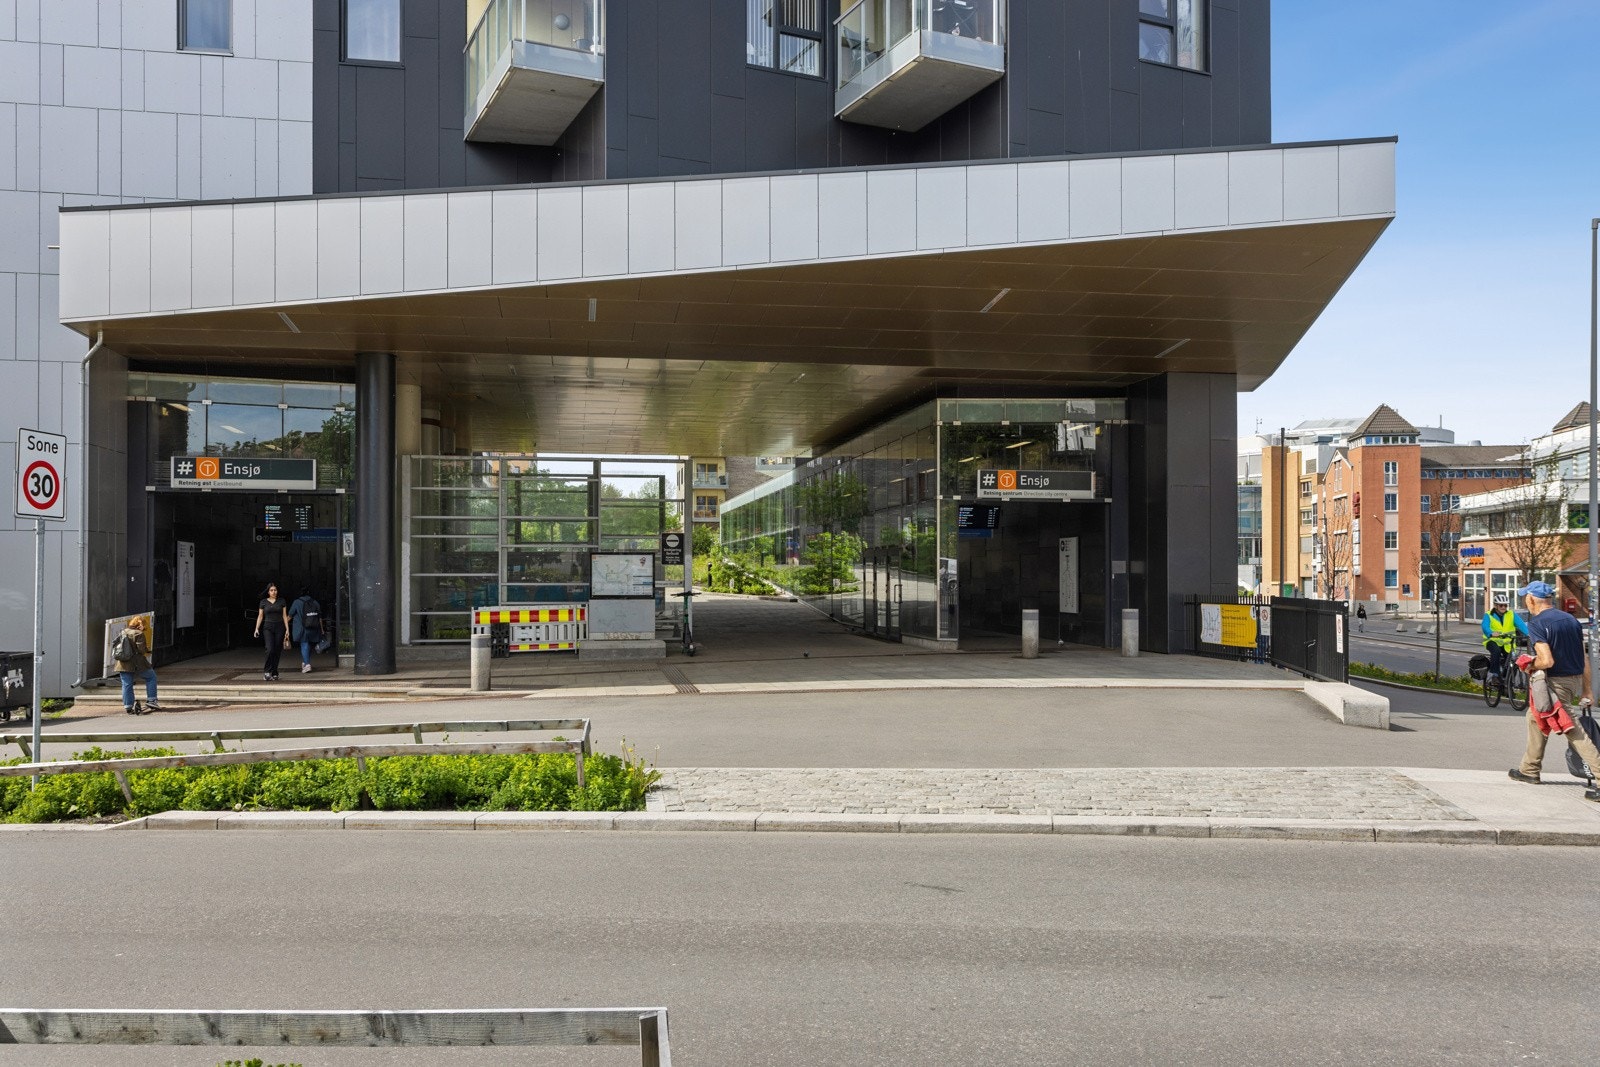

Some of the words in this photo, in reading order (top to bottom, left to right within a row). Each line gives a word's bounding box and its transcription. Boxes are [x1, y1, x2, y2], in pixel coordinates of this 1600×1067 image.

[27, 435, 59, 454] Sone
[224, 463, 261, 477] Ensjø
[30, 472, 54, 498] 30
[1020, 475, 1050, 488] Ensjø
